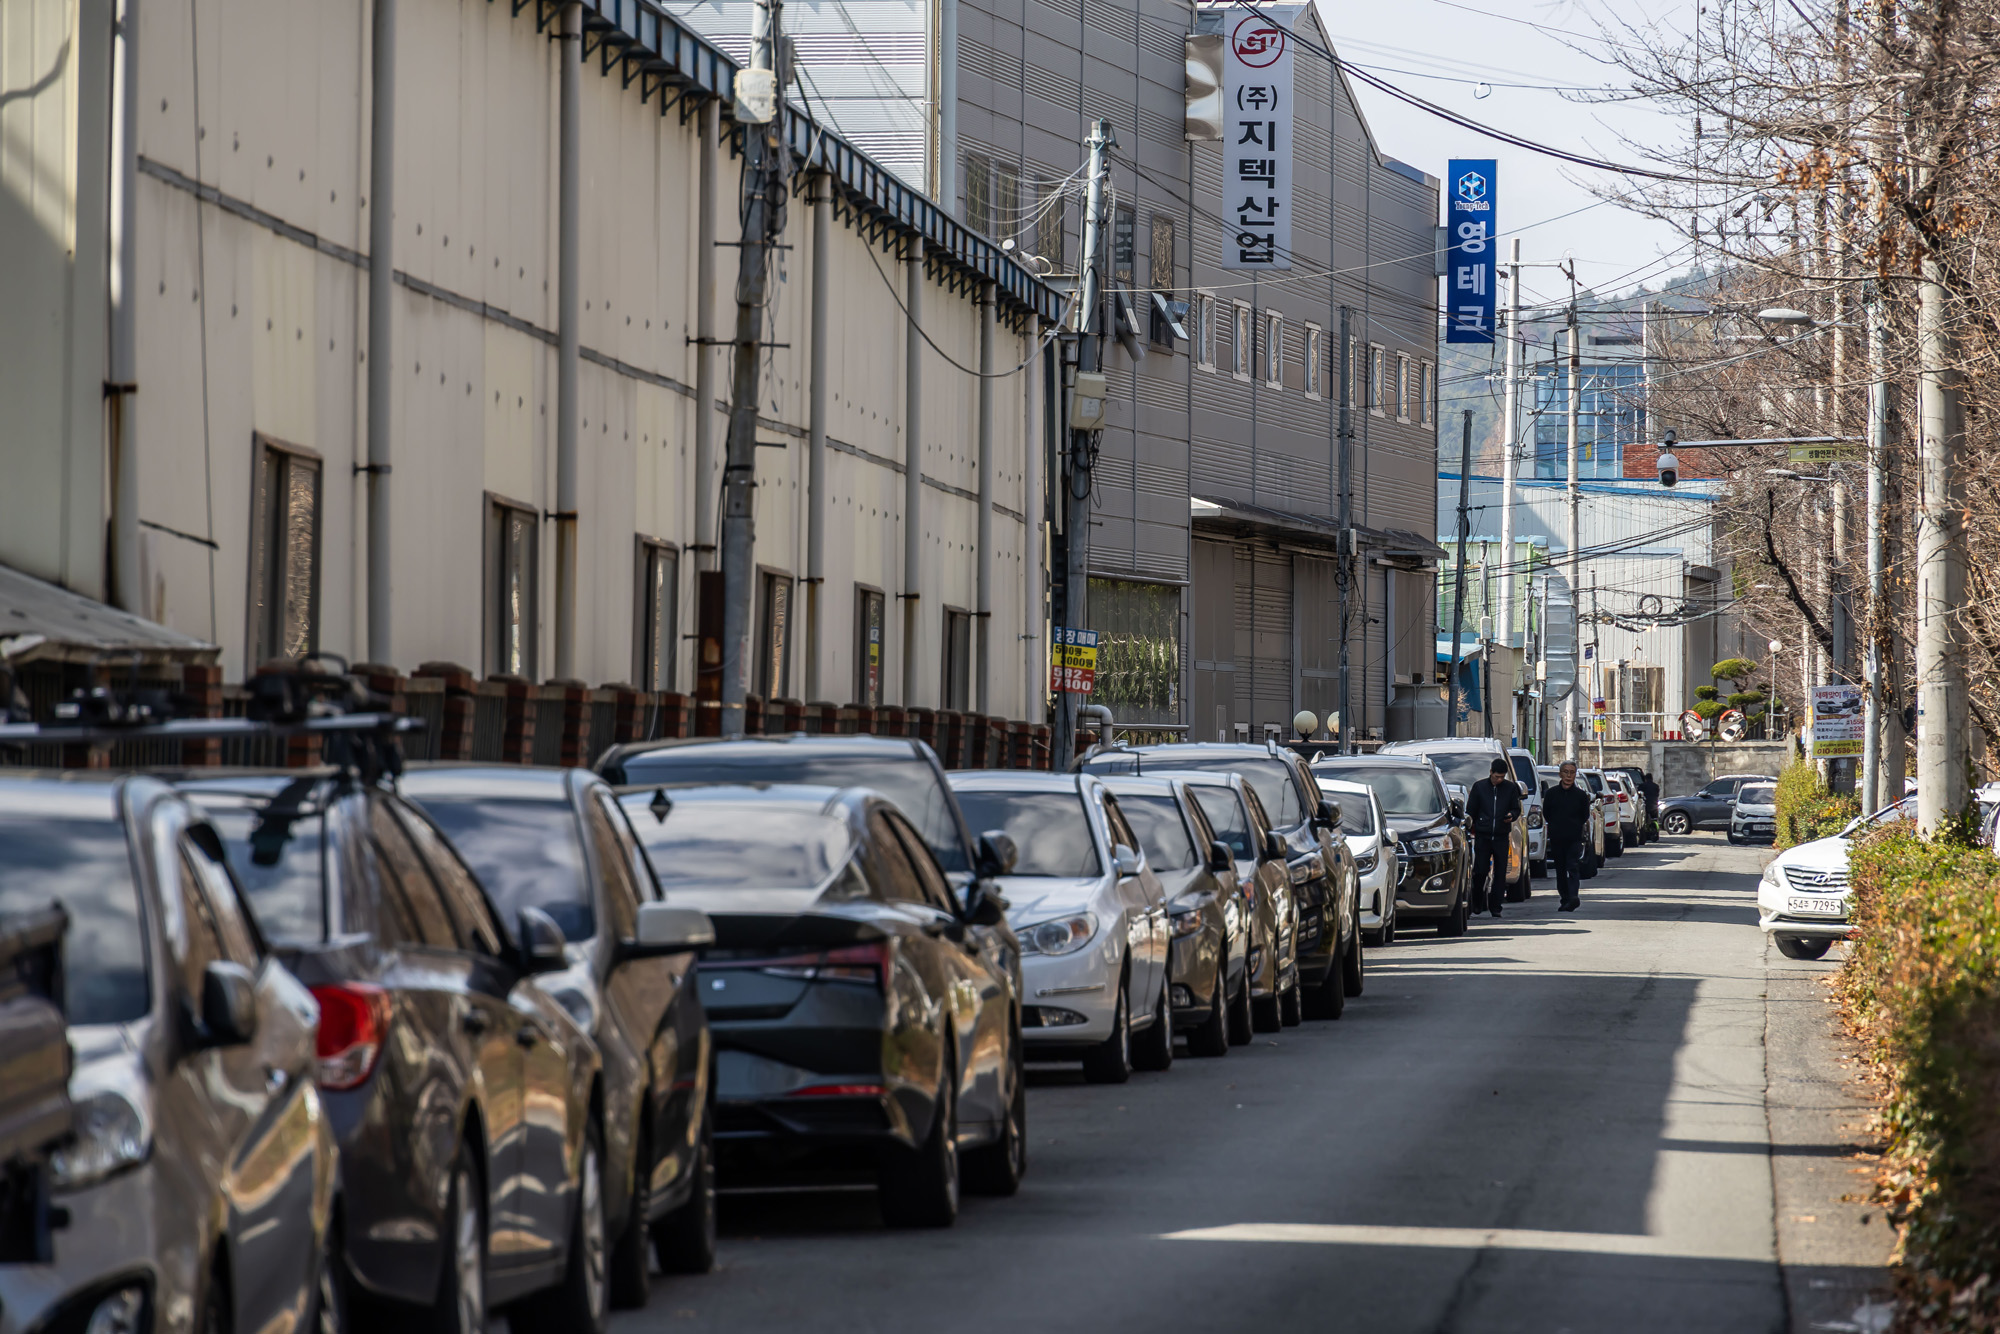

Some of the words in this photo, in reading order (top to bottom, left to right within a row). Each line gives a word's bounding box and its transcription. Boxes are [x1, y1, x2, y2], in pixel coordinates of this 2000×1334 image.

[1236, 84, 1278, 111] (주)
[1236, 120, 1279, 264] 지텍산업
[1454, 200, 1490, 213] Young-Tech
[1455, 220, 1488, 332] 영테크
[1056, 629, 1076, 643] 공장
[1077, 632, 1096, 645] 매매
[1053, 677, 1092, 691] 7400
[1812, 900, 1836, 911] 7295
